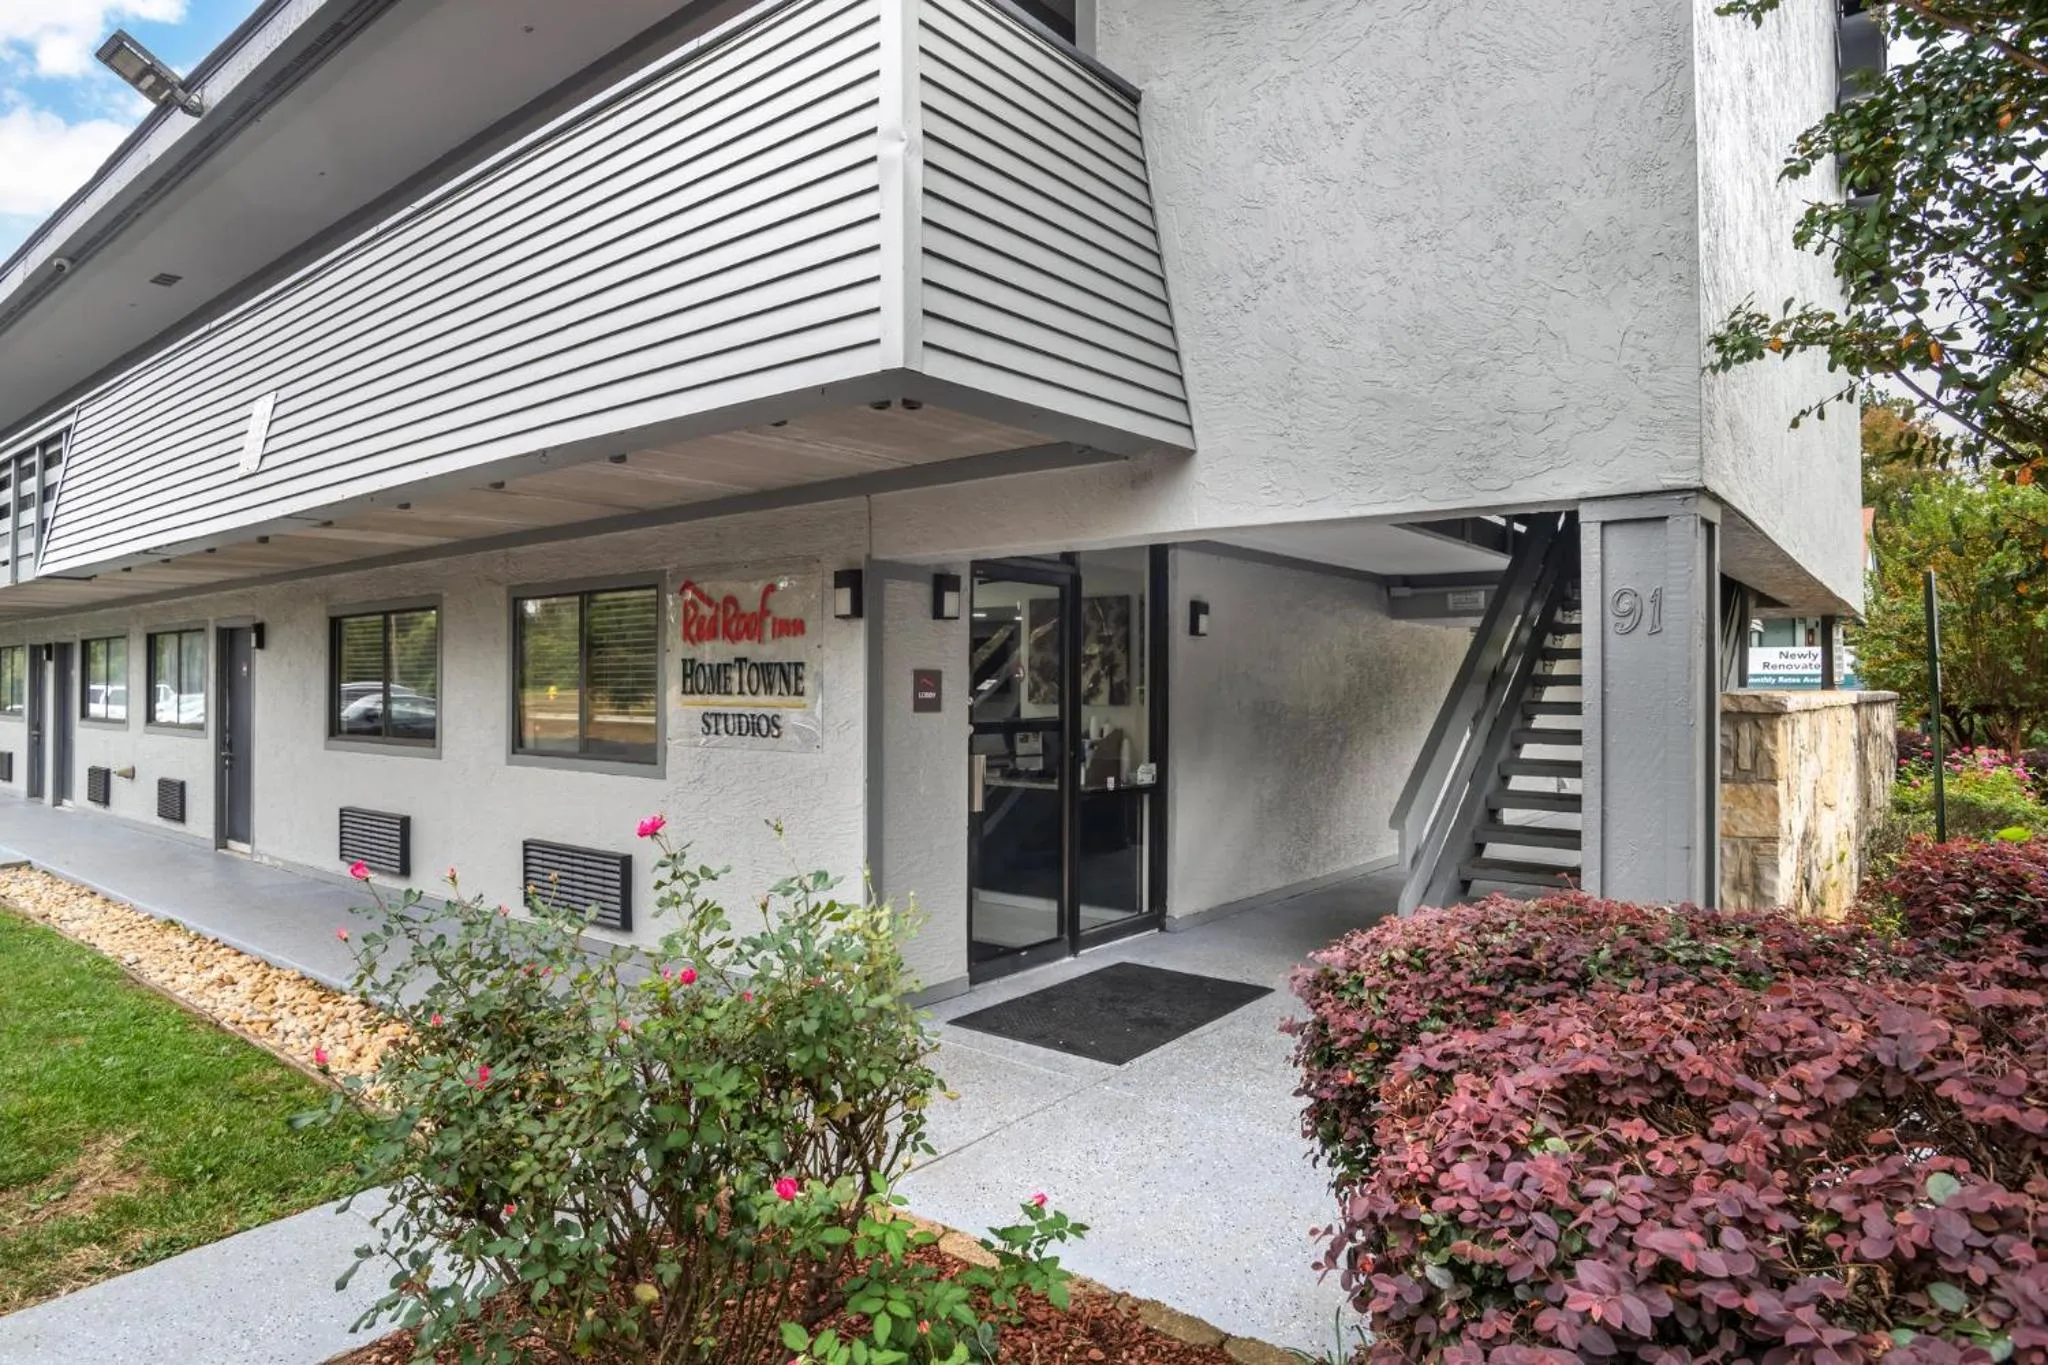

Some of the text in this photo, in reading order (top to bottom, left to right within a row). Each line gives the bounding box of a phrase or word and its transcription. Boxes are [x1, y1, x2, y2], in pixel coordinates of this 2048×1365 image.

[682, 599, 720, 646] Red
[722, 583, 777, 645] Roof
[1611, 586, 1663, 636] 91
[1762, 661, 1821, 671] Renovate
[1779, 650, 1819, 662] Newly
[701, 712, 783, 739] STUDIOS
